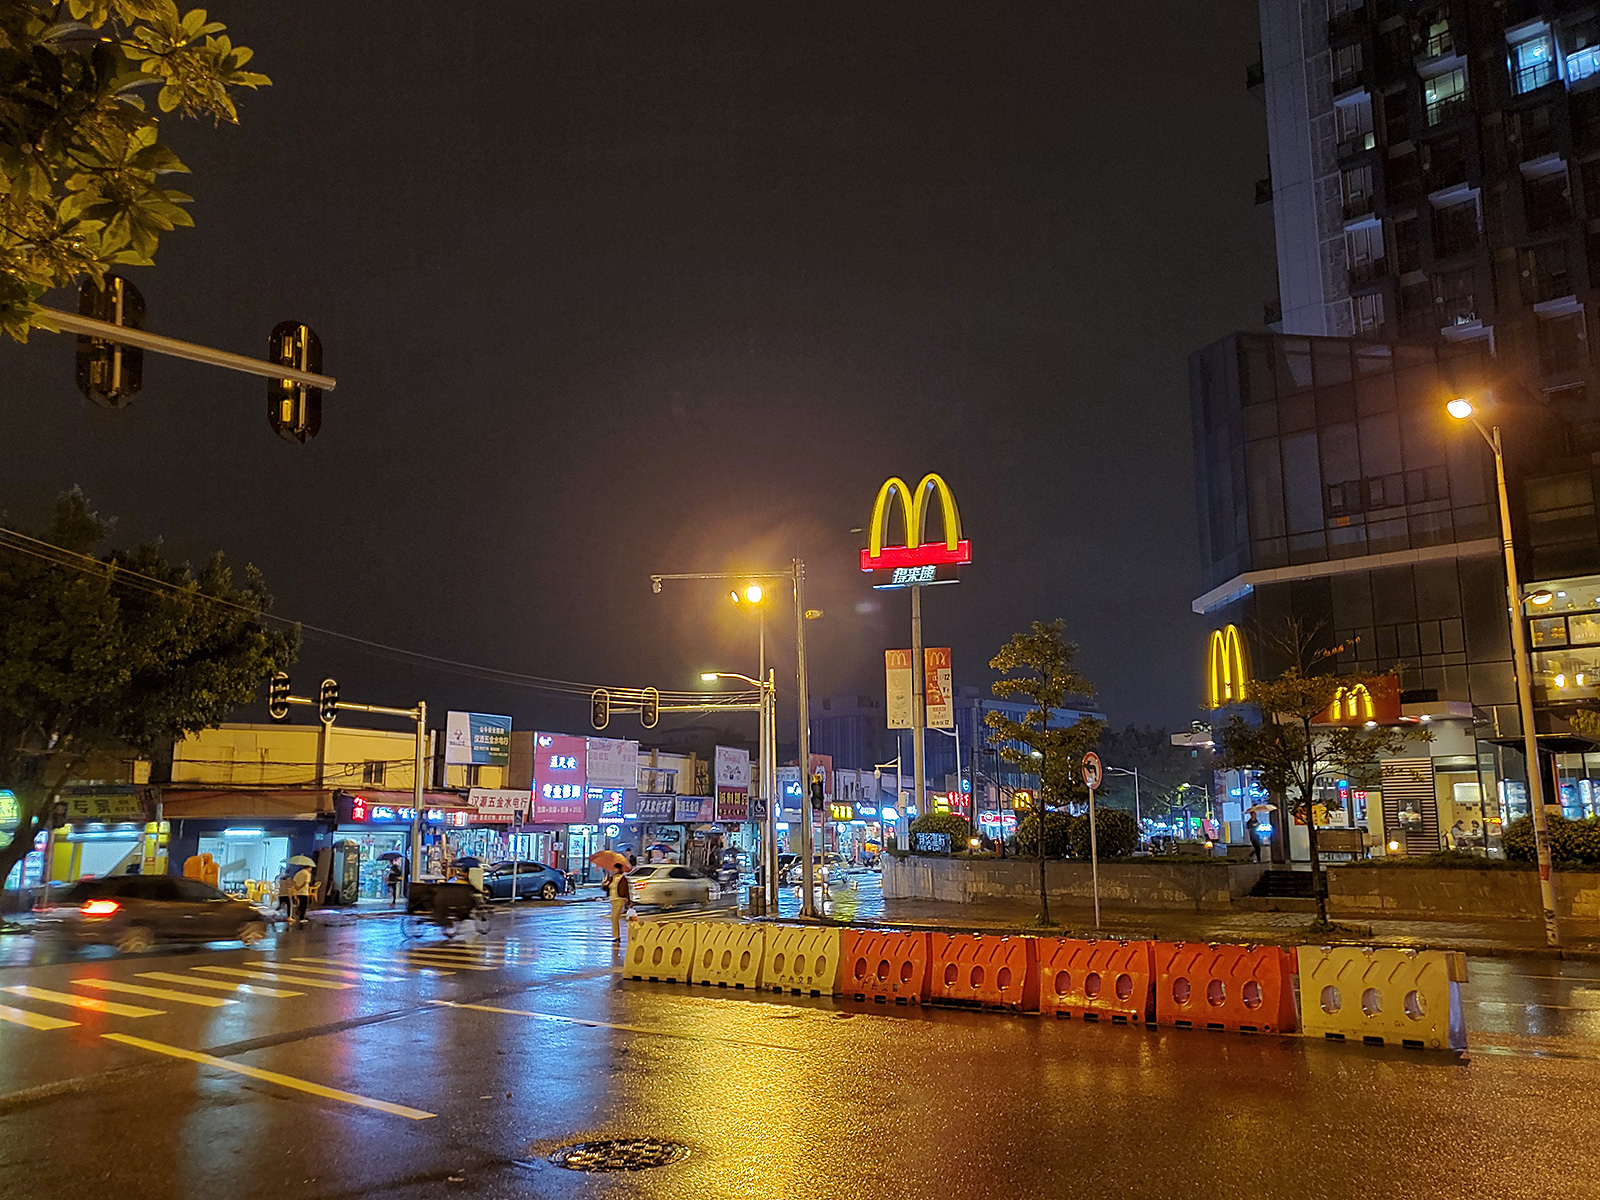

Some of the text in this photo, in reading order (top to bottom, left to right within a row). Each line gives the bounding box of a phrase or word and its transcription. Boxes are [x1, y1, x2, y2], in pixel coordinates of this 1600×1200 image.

[892, 564, 936, 584] 得来速
[472, 795, 528, 809] 汉源五金水电行
